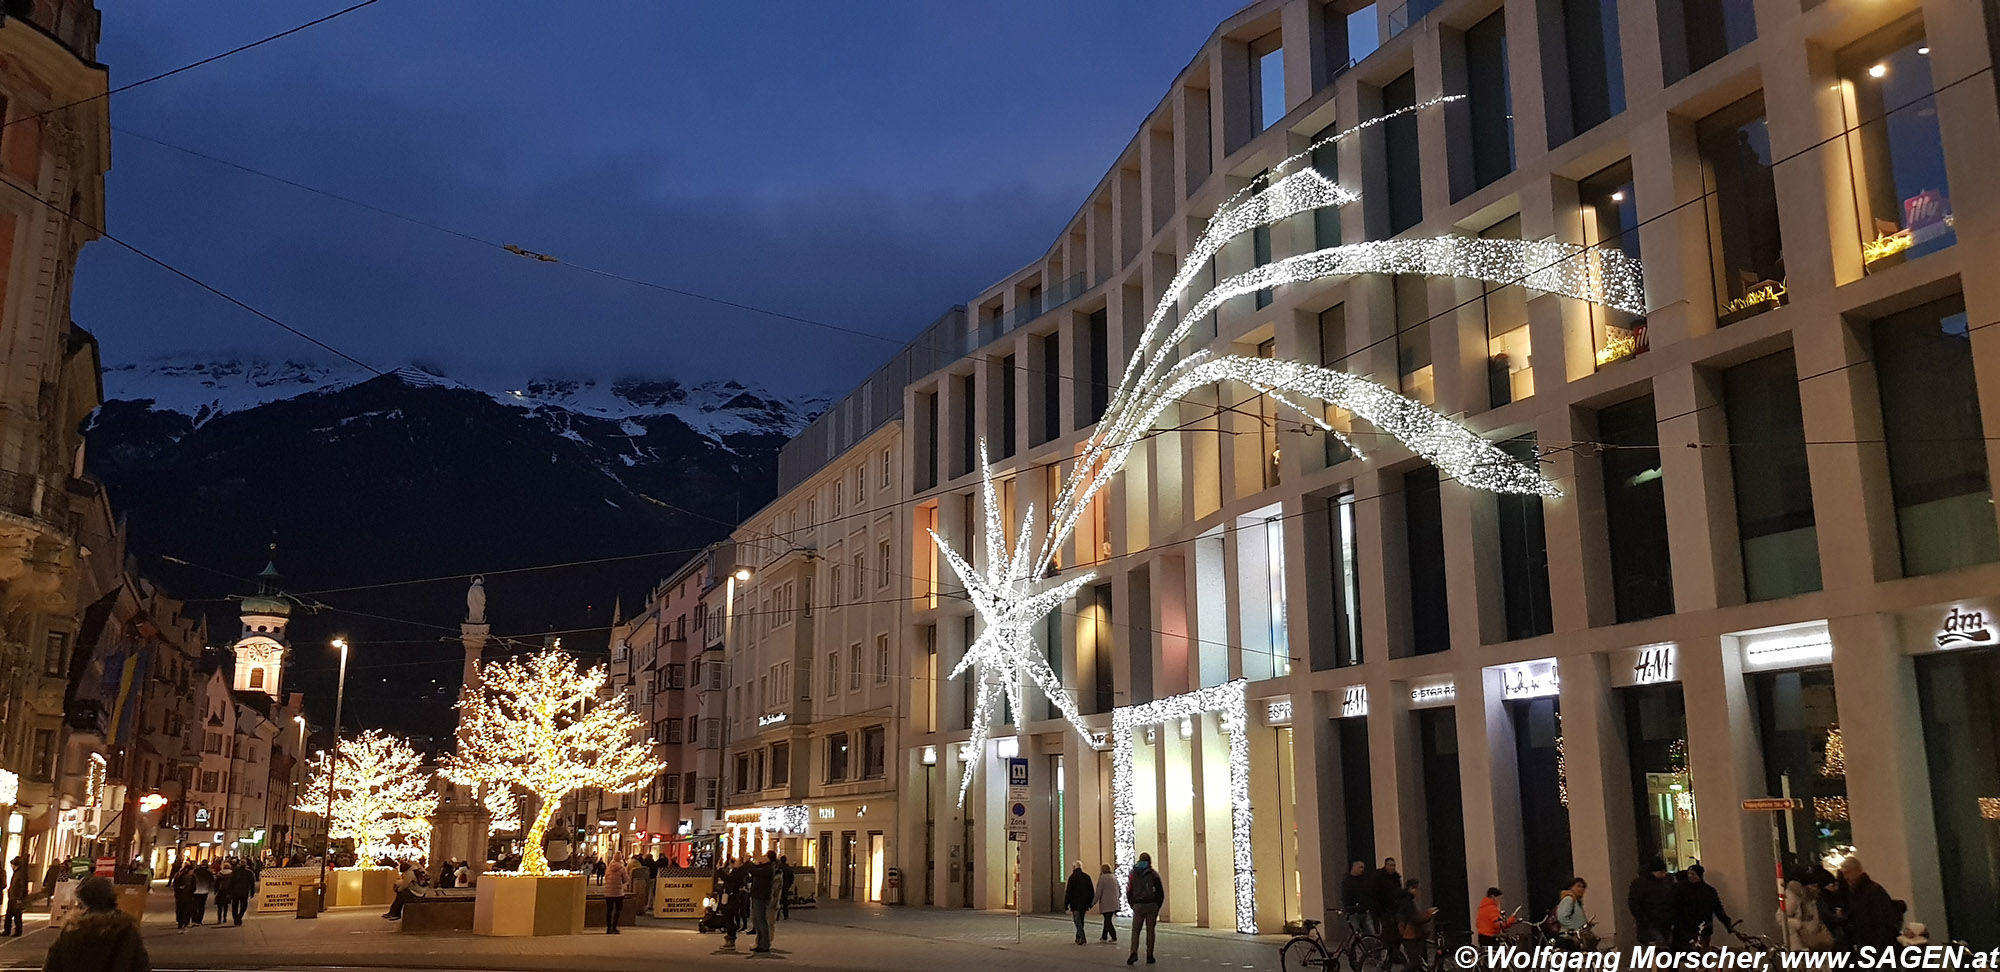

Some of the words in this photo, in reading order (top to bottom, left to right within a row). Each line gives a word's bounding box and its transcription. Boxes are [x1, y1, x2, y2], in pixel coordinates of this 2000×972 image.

[1943, 608, 1983, 632] dm
[1634, 648, 1673, 682] H&M
[1342, 688, 1368, 715] H&M
[1010, 817, 1027, 826] Zone
